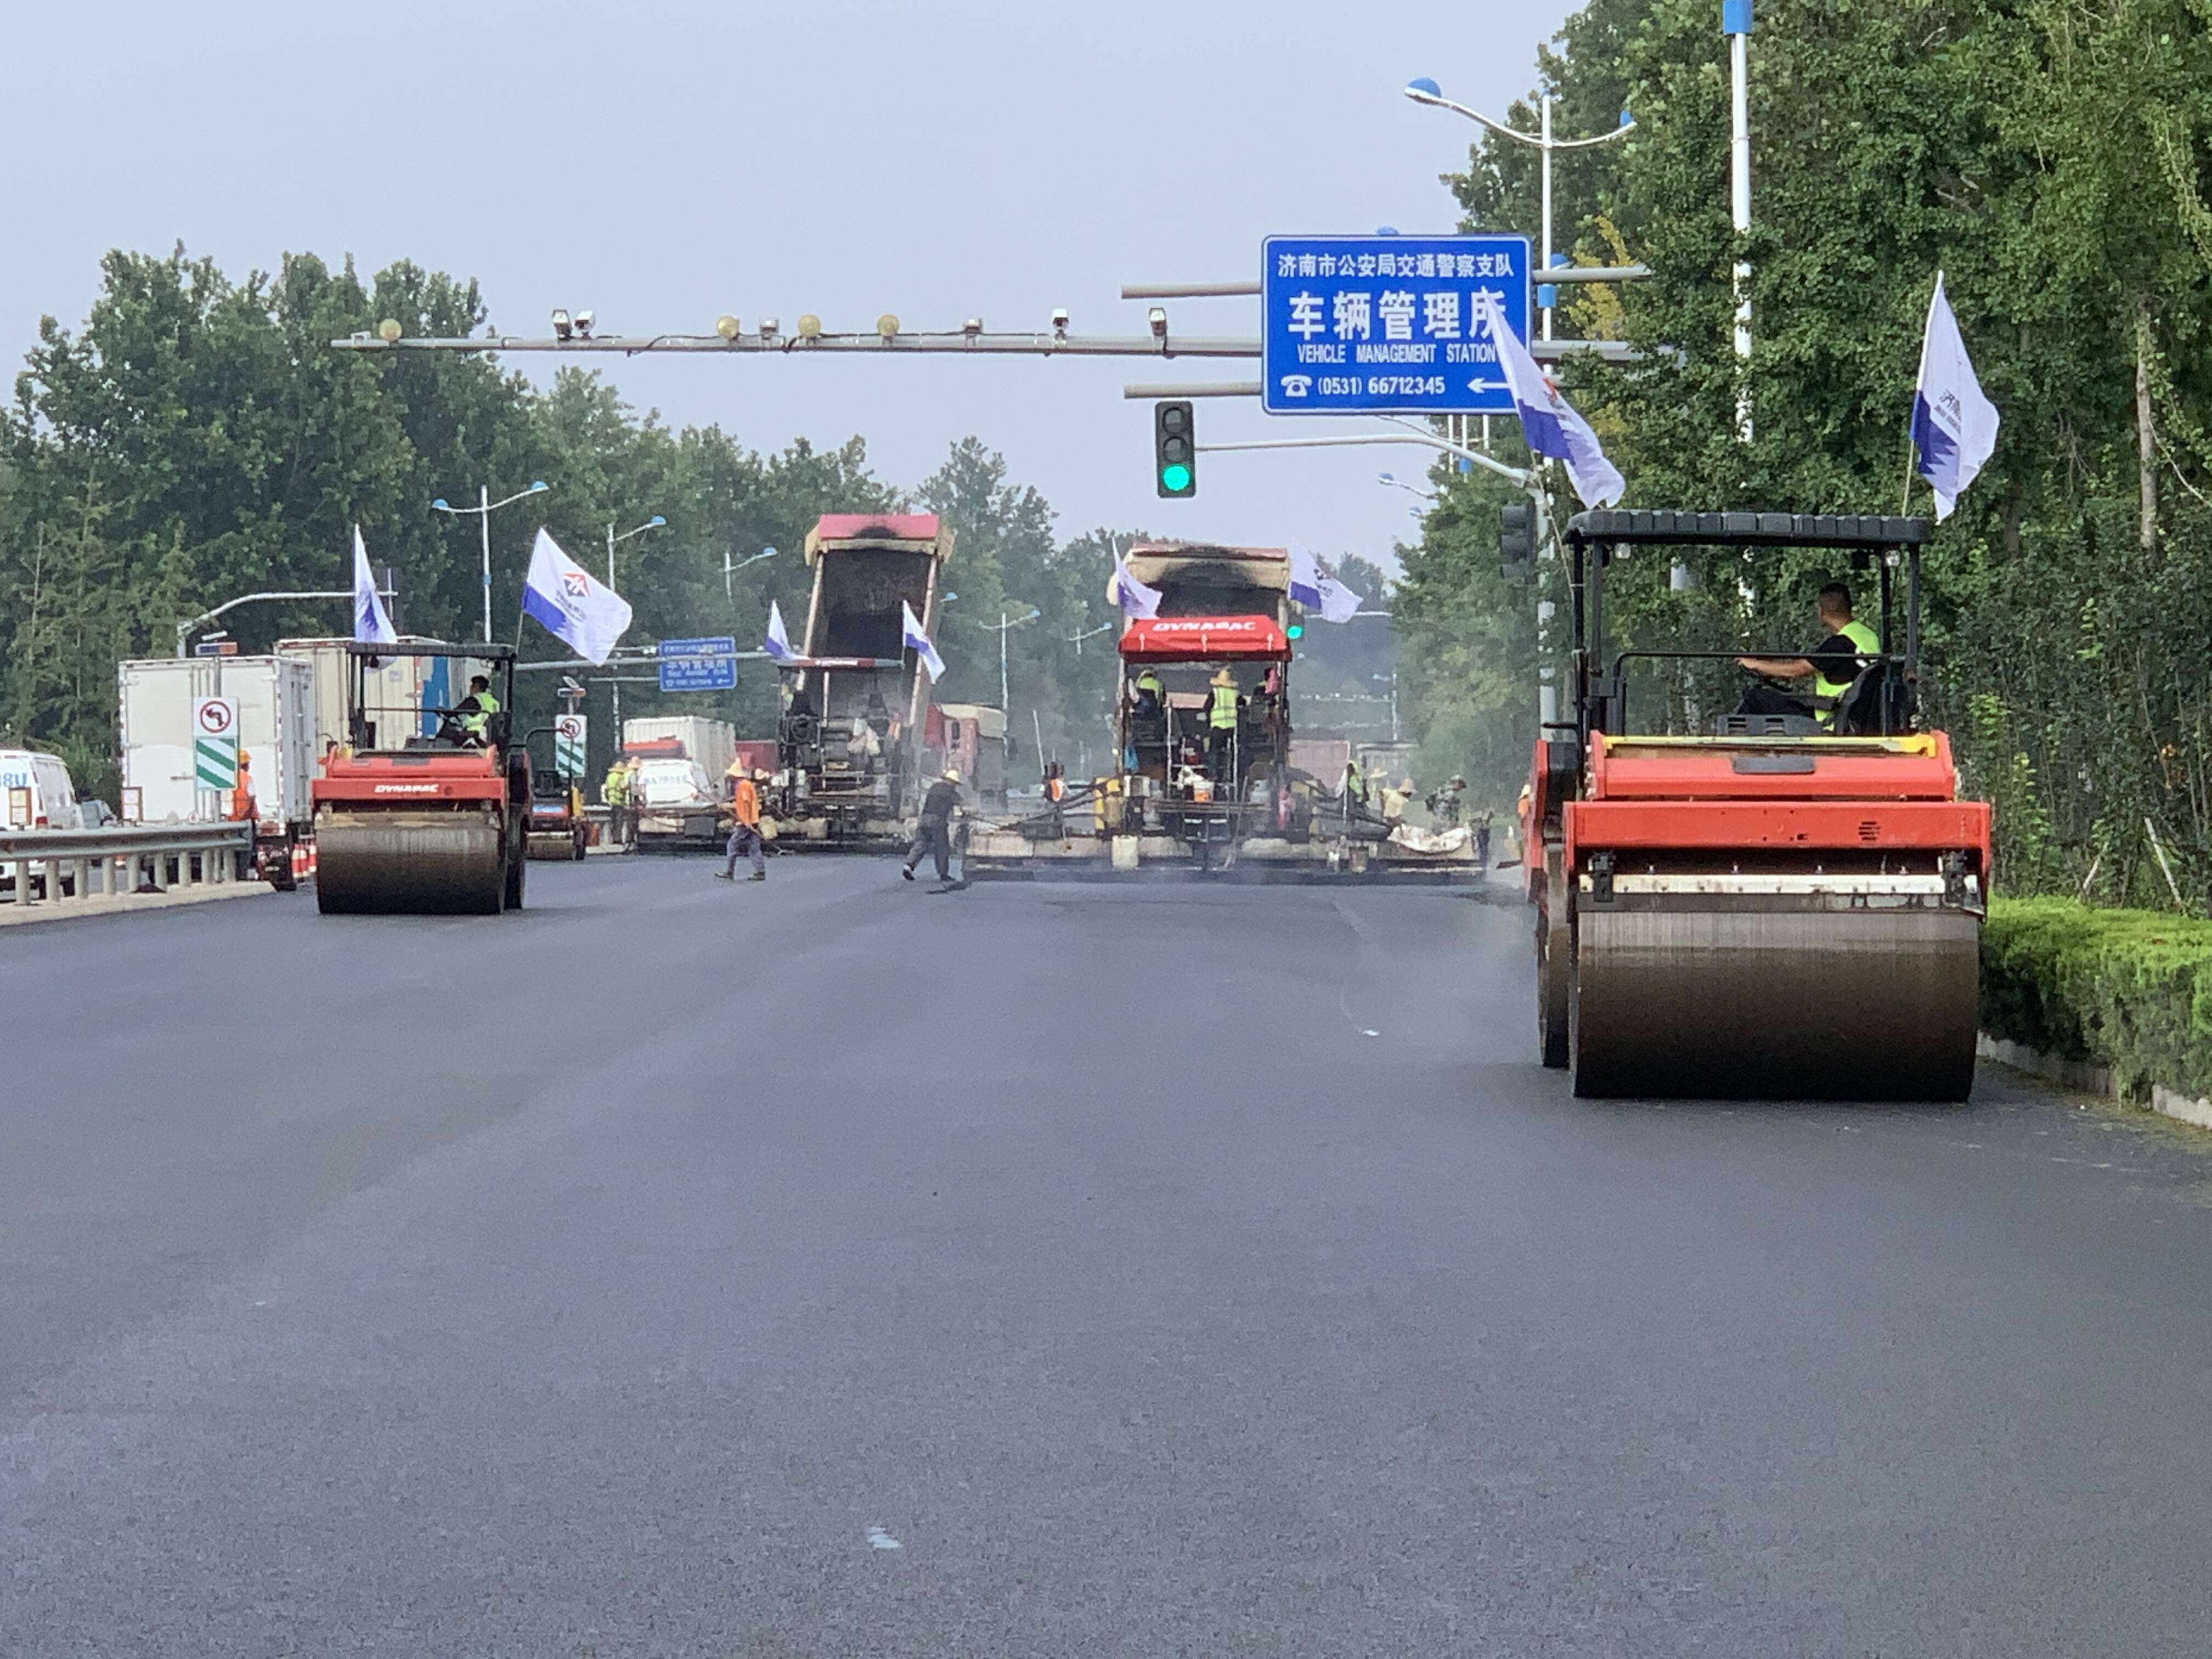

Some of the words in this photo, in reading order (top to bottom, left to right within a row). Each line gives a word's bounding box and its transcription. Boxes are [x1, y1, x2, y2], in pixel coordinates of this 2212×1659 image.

[1278, 253, 1514, 277] 济南市公安局交通警察支队
[1288, 288, 1506, 340] 车辆管理所
[1297, 344, 1346, 363] VEHICLE
[1357, 344, 1436, 363] MANAGEMENT
[1446, 344, 1497, 363] STATION
[1318, 376, 1362, 395] (0531)
[1368, 376, 1445, 395] 66712345
